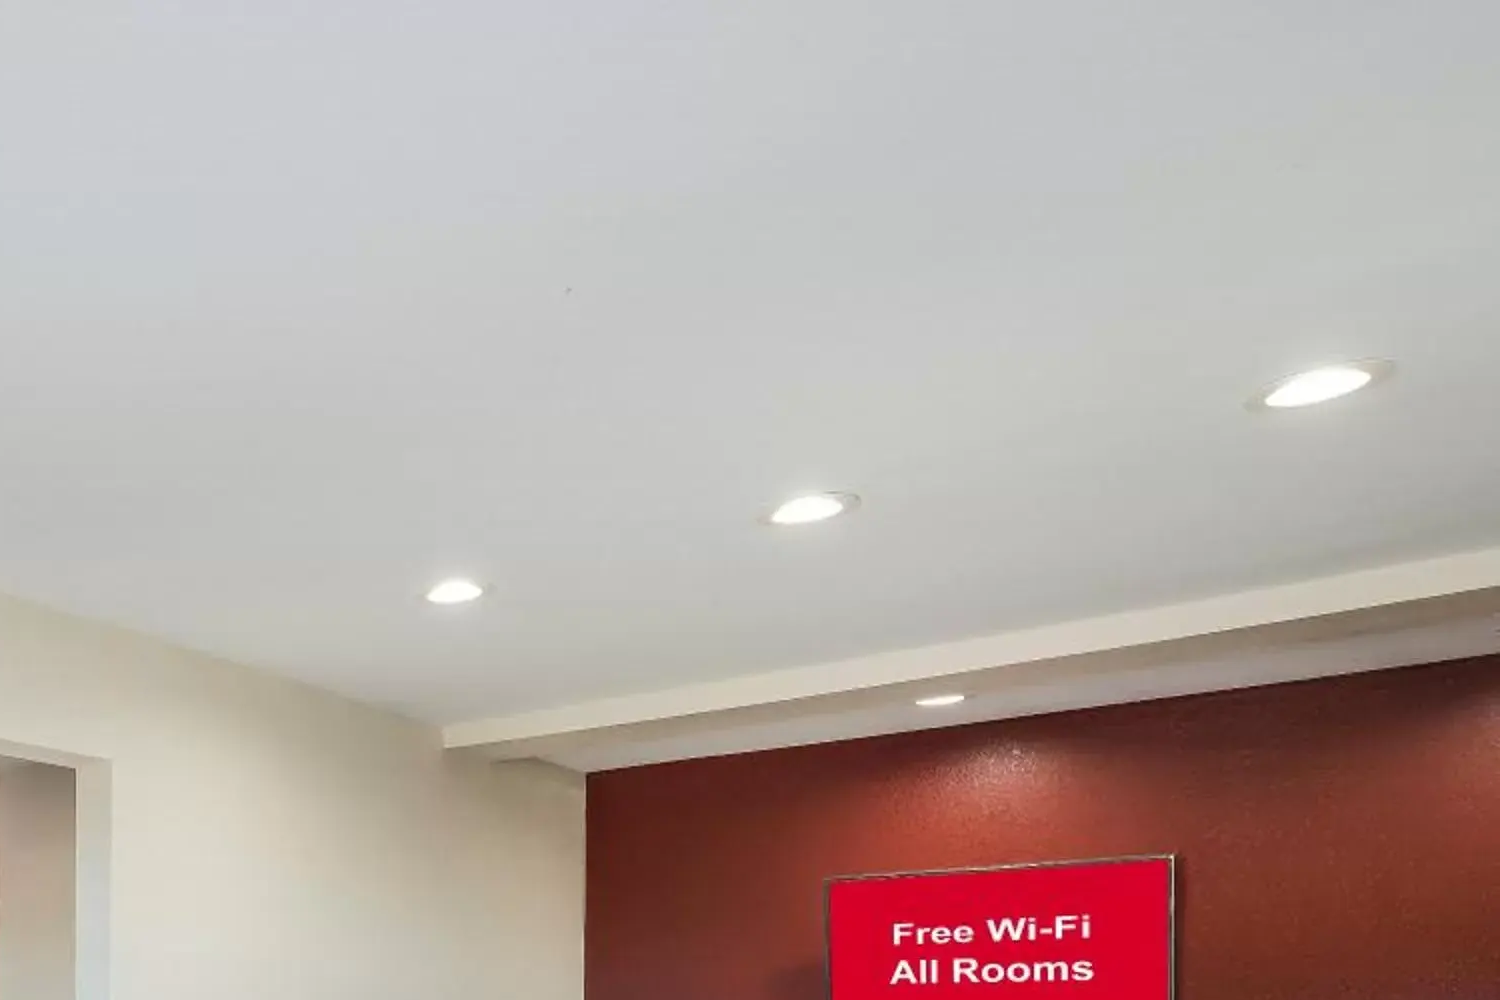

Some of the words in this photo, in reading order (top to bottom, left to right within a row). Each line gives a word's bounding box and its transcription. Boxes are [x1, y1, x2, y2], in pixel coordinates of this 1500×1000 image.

[893, 922, 975, 946] Free
[986, 914, 1091, 942] Wi-Fi
[890, 958, 939, 985] All
[953, 958, 1094, 984] Rooms
